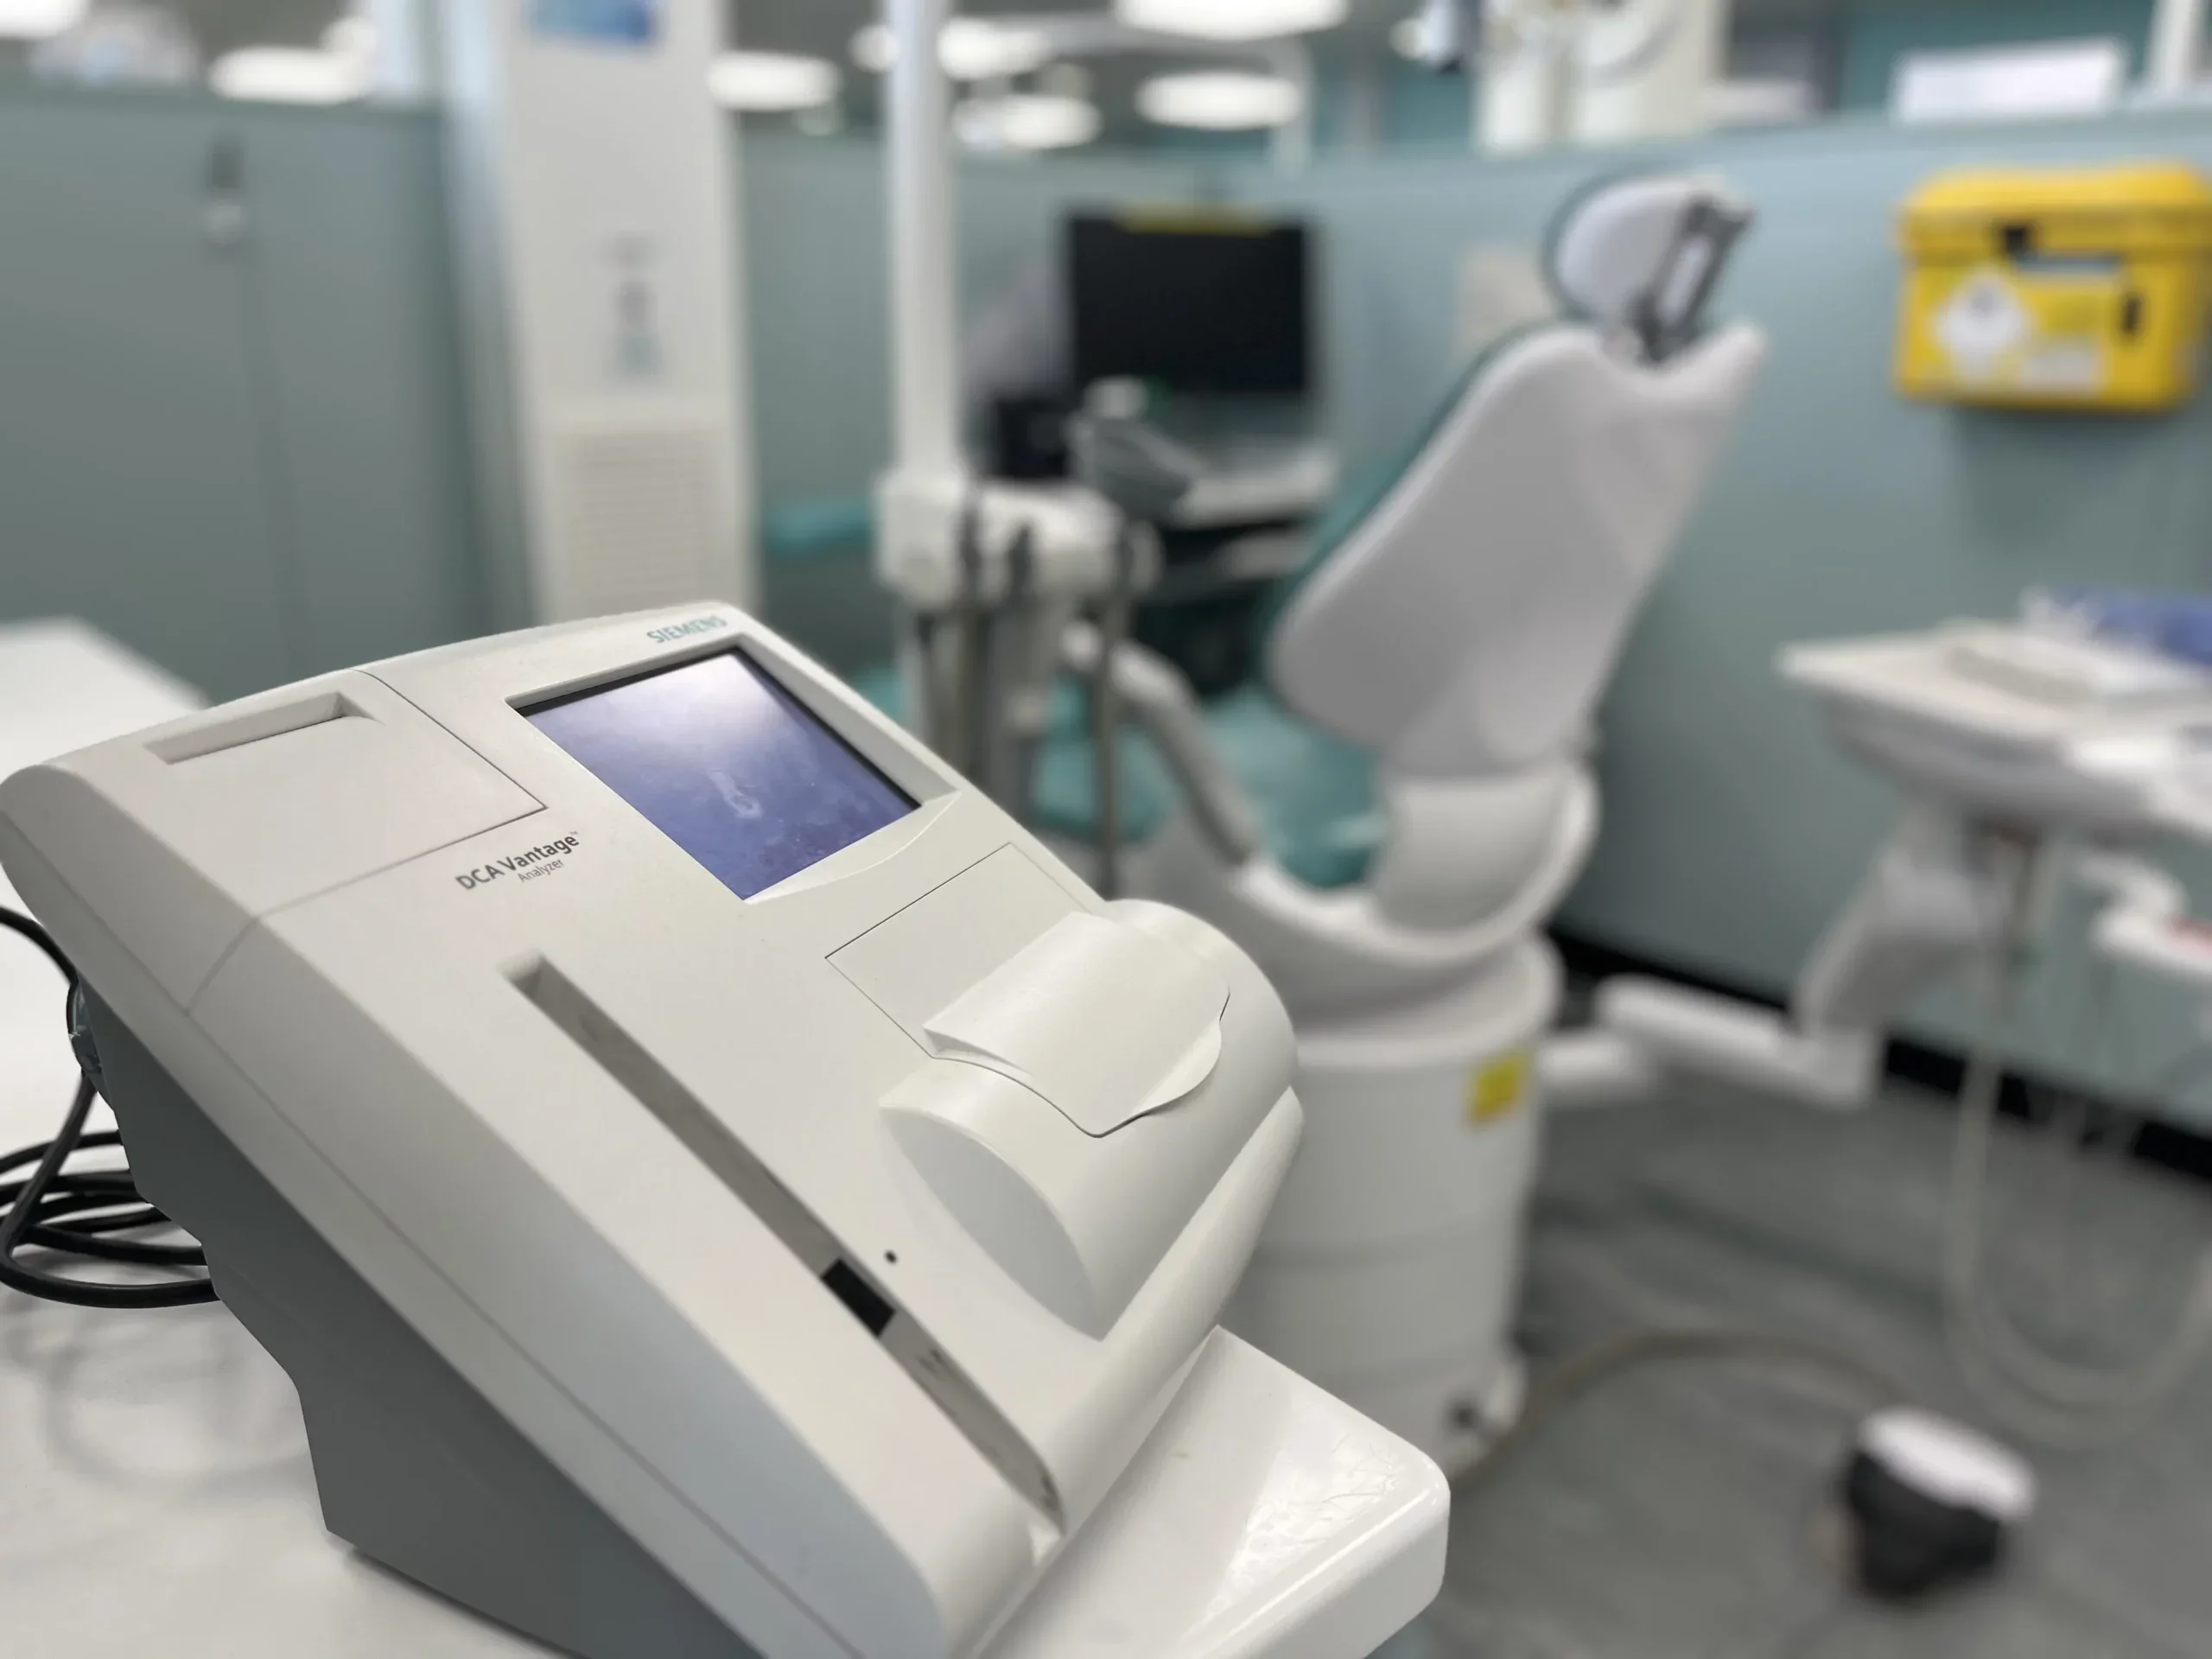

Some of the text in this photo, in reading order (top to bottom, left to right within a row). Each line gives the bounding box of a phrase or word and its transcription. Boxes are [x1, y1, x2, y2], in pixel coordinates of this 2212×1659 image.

[646, 615, 727, 643] SIEMENS
[455, 864, 505, 890] DCA
[518, 859, 564, 883] Analyzer
